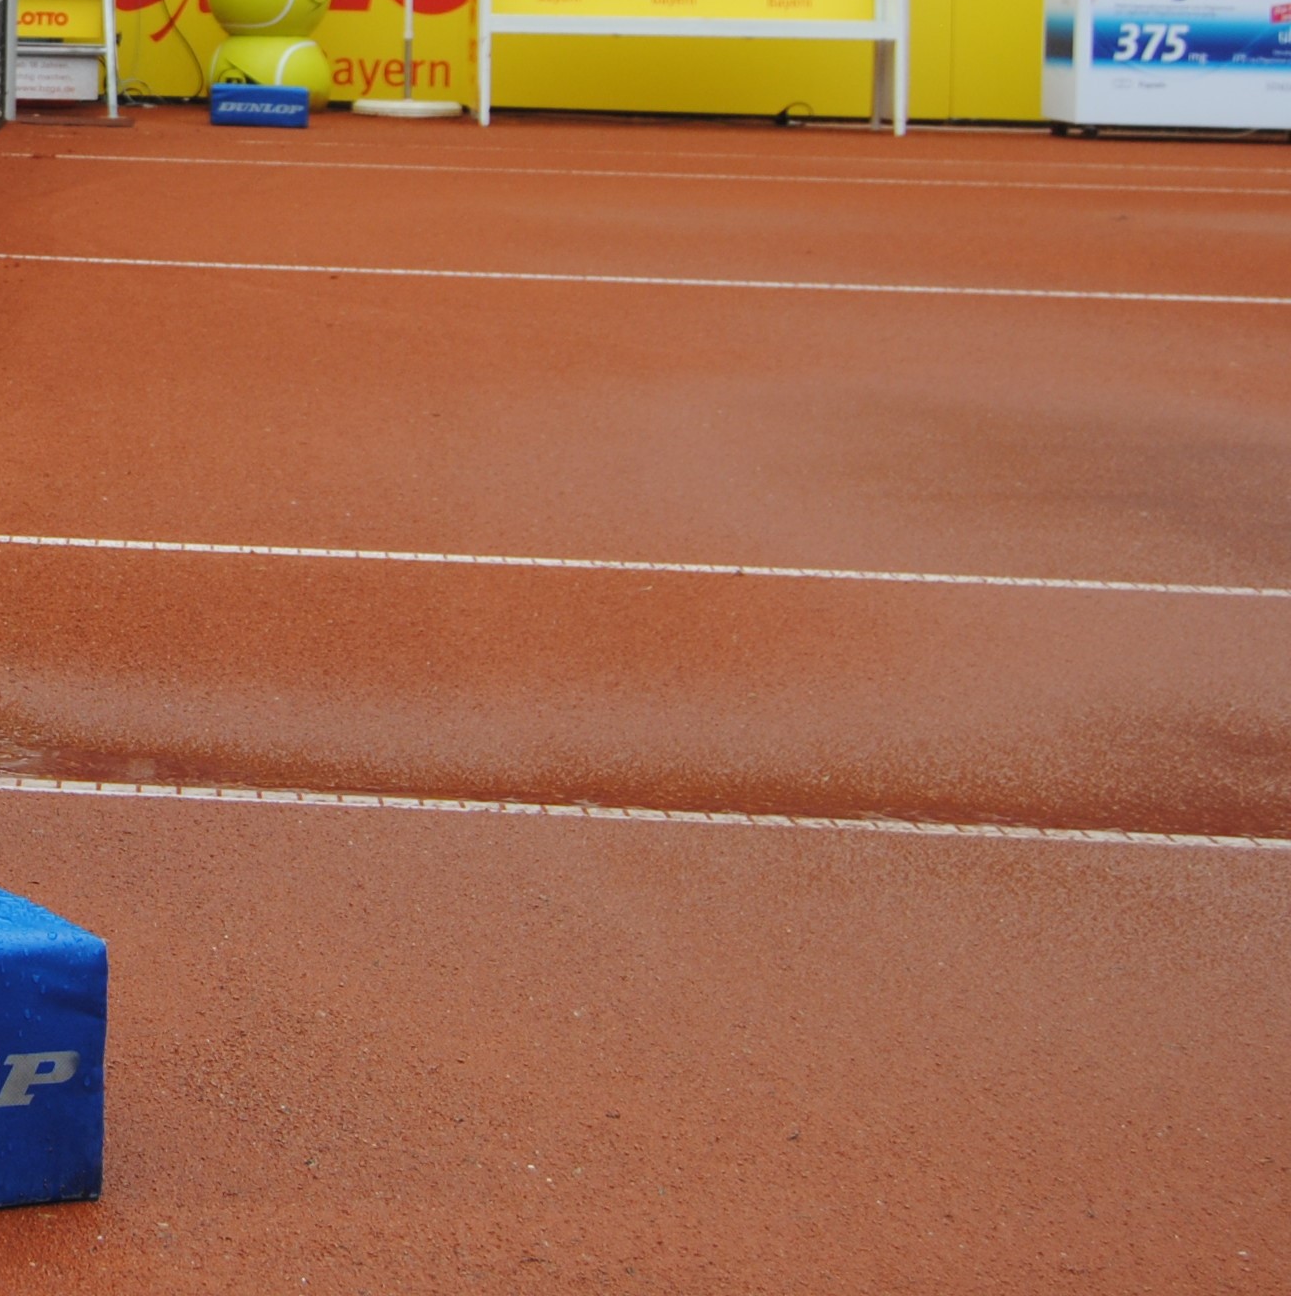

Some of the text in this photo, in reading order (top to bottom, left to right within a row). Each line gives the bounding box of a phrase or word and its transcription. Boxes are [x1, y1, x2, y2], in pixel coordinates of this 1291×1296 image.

[16, 11, 69, 26] OTTO
[1113, 22, 1190, 63] 375
[332, 57, 451, 96] ayern
[218, 101, 305, 115] DUNLOP
